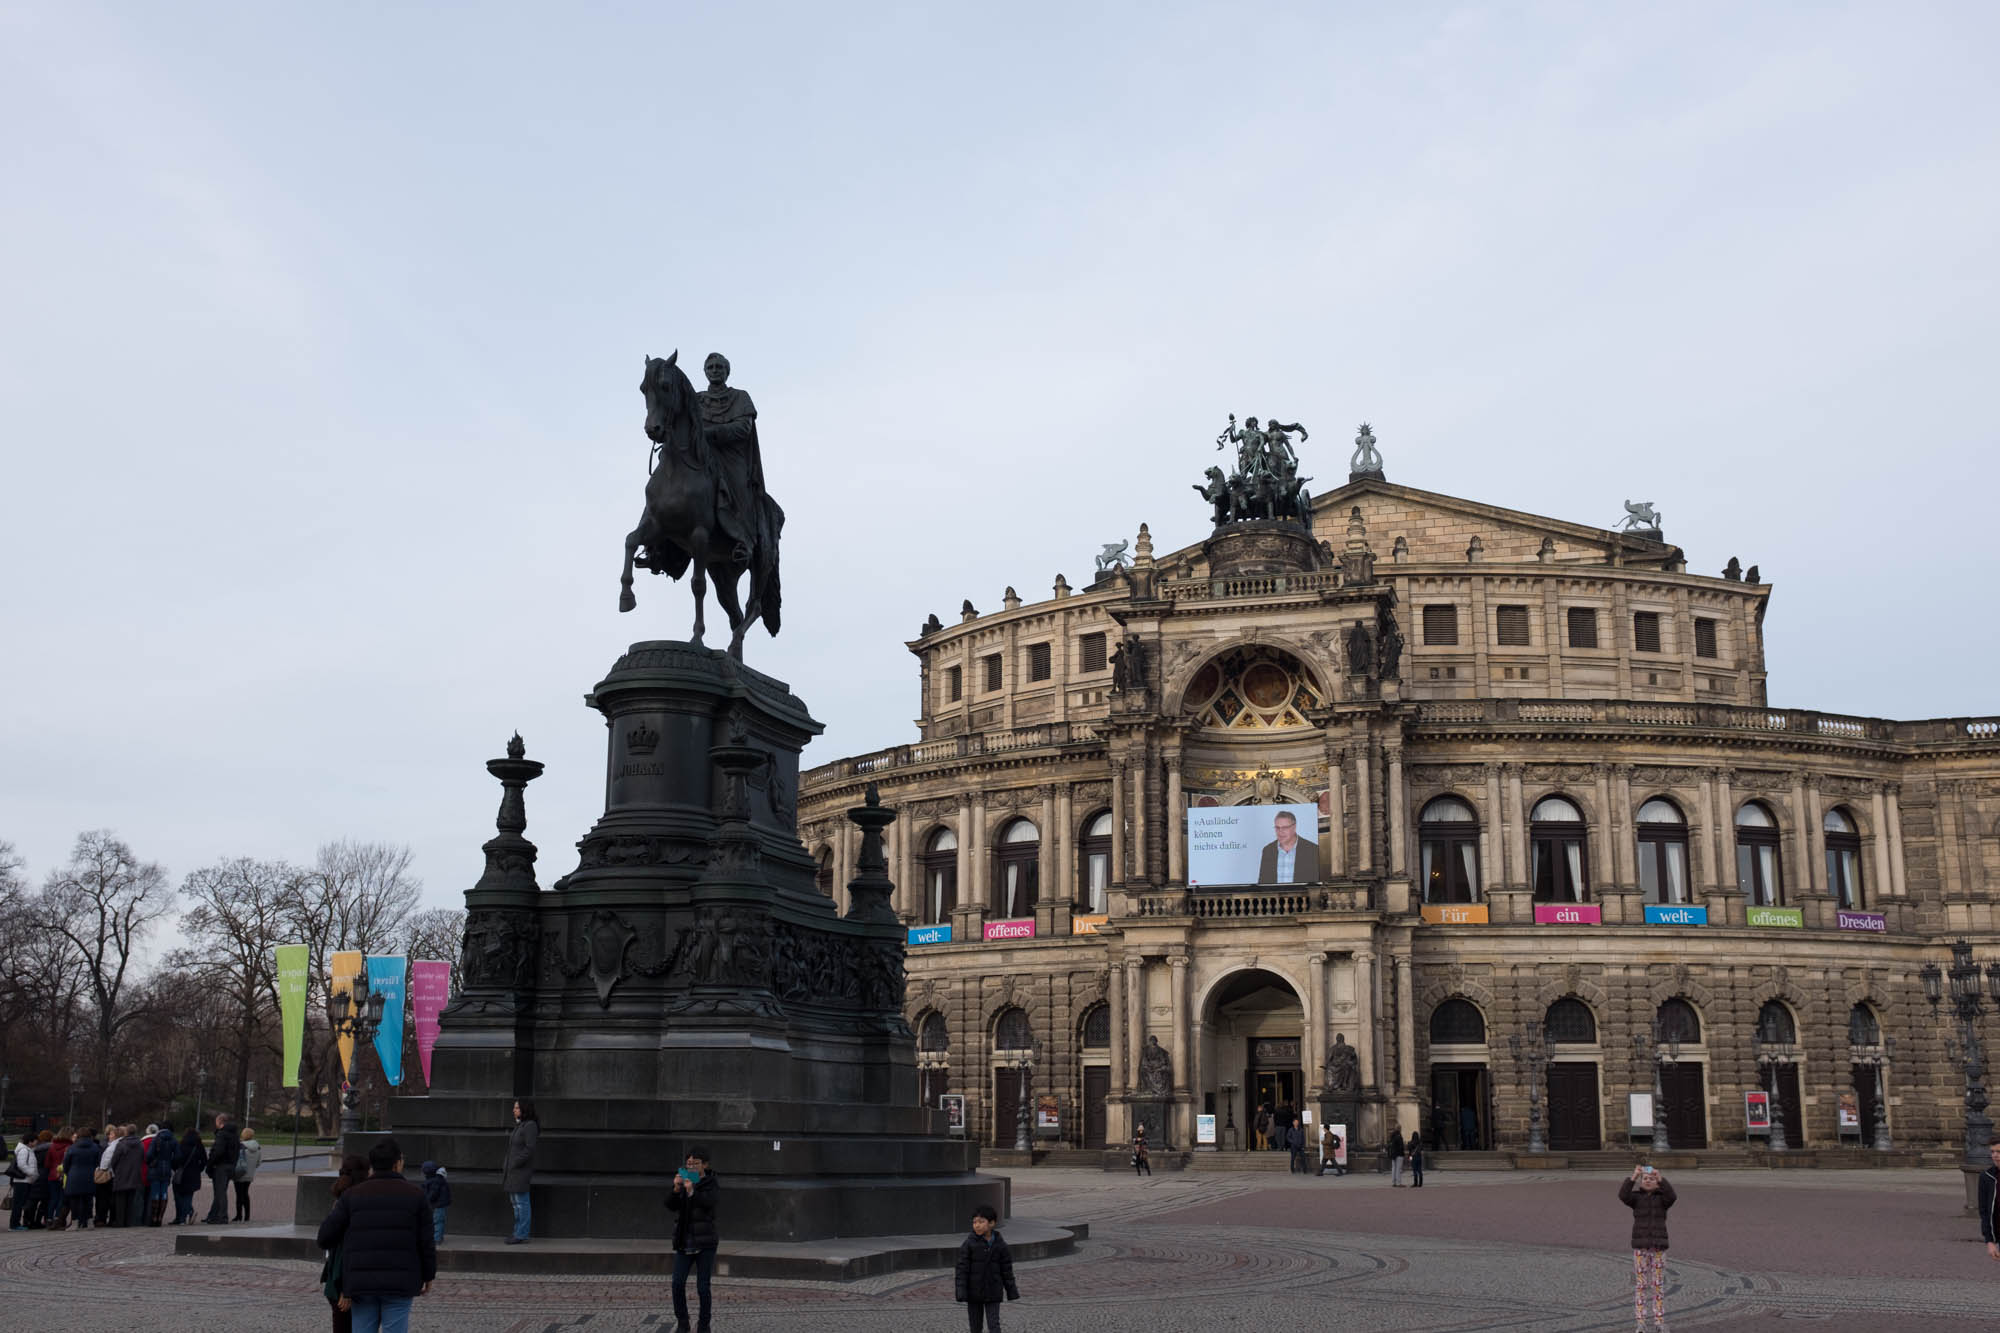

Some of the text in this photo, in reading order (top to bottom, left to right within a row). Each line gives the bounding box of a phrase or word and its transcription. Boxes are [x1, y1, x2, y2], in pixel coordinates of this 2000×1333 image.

[1194, 830, 1223, 839] können
[1194, 841, 1218, 851] nichts
[1441, 909, 1469, 922] Für
[1556, 908, 1580, 922] ein
[1659, 909, 1694, 923] welt-
[1752, 912, 1798, 926] offenes
[1839, 914, 1885, 930] Dresden
[917, 930, 942, 943] welt-
[988, 924, 1031, 938] offenes
